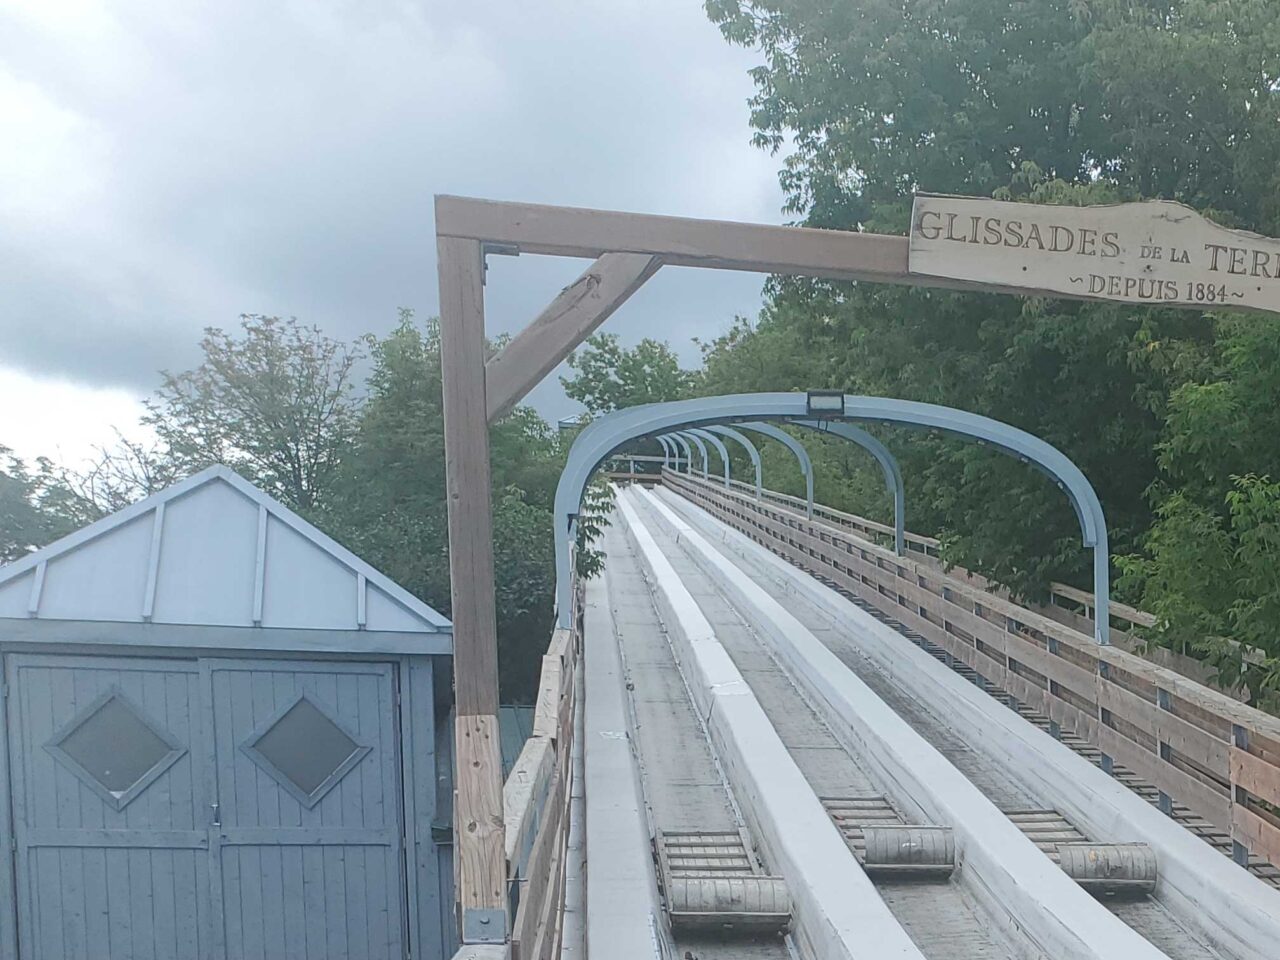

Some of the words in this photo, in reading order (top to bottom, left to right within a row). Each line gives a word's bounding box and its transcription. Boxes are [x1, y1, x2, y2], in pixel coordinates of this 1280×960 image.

[919, 211, 1121, 258] GLISSADES
[1140, 244, 1162, 259] DE
[1170, 248, 1190, 264] LA
[1088, 274, 1179, 300] DEPUIS
[1186, 282, 1228, 302] 1884
